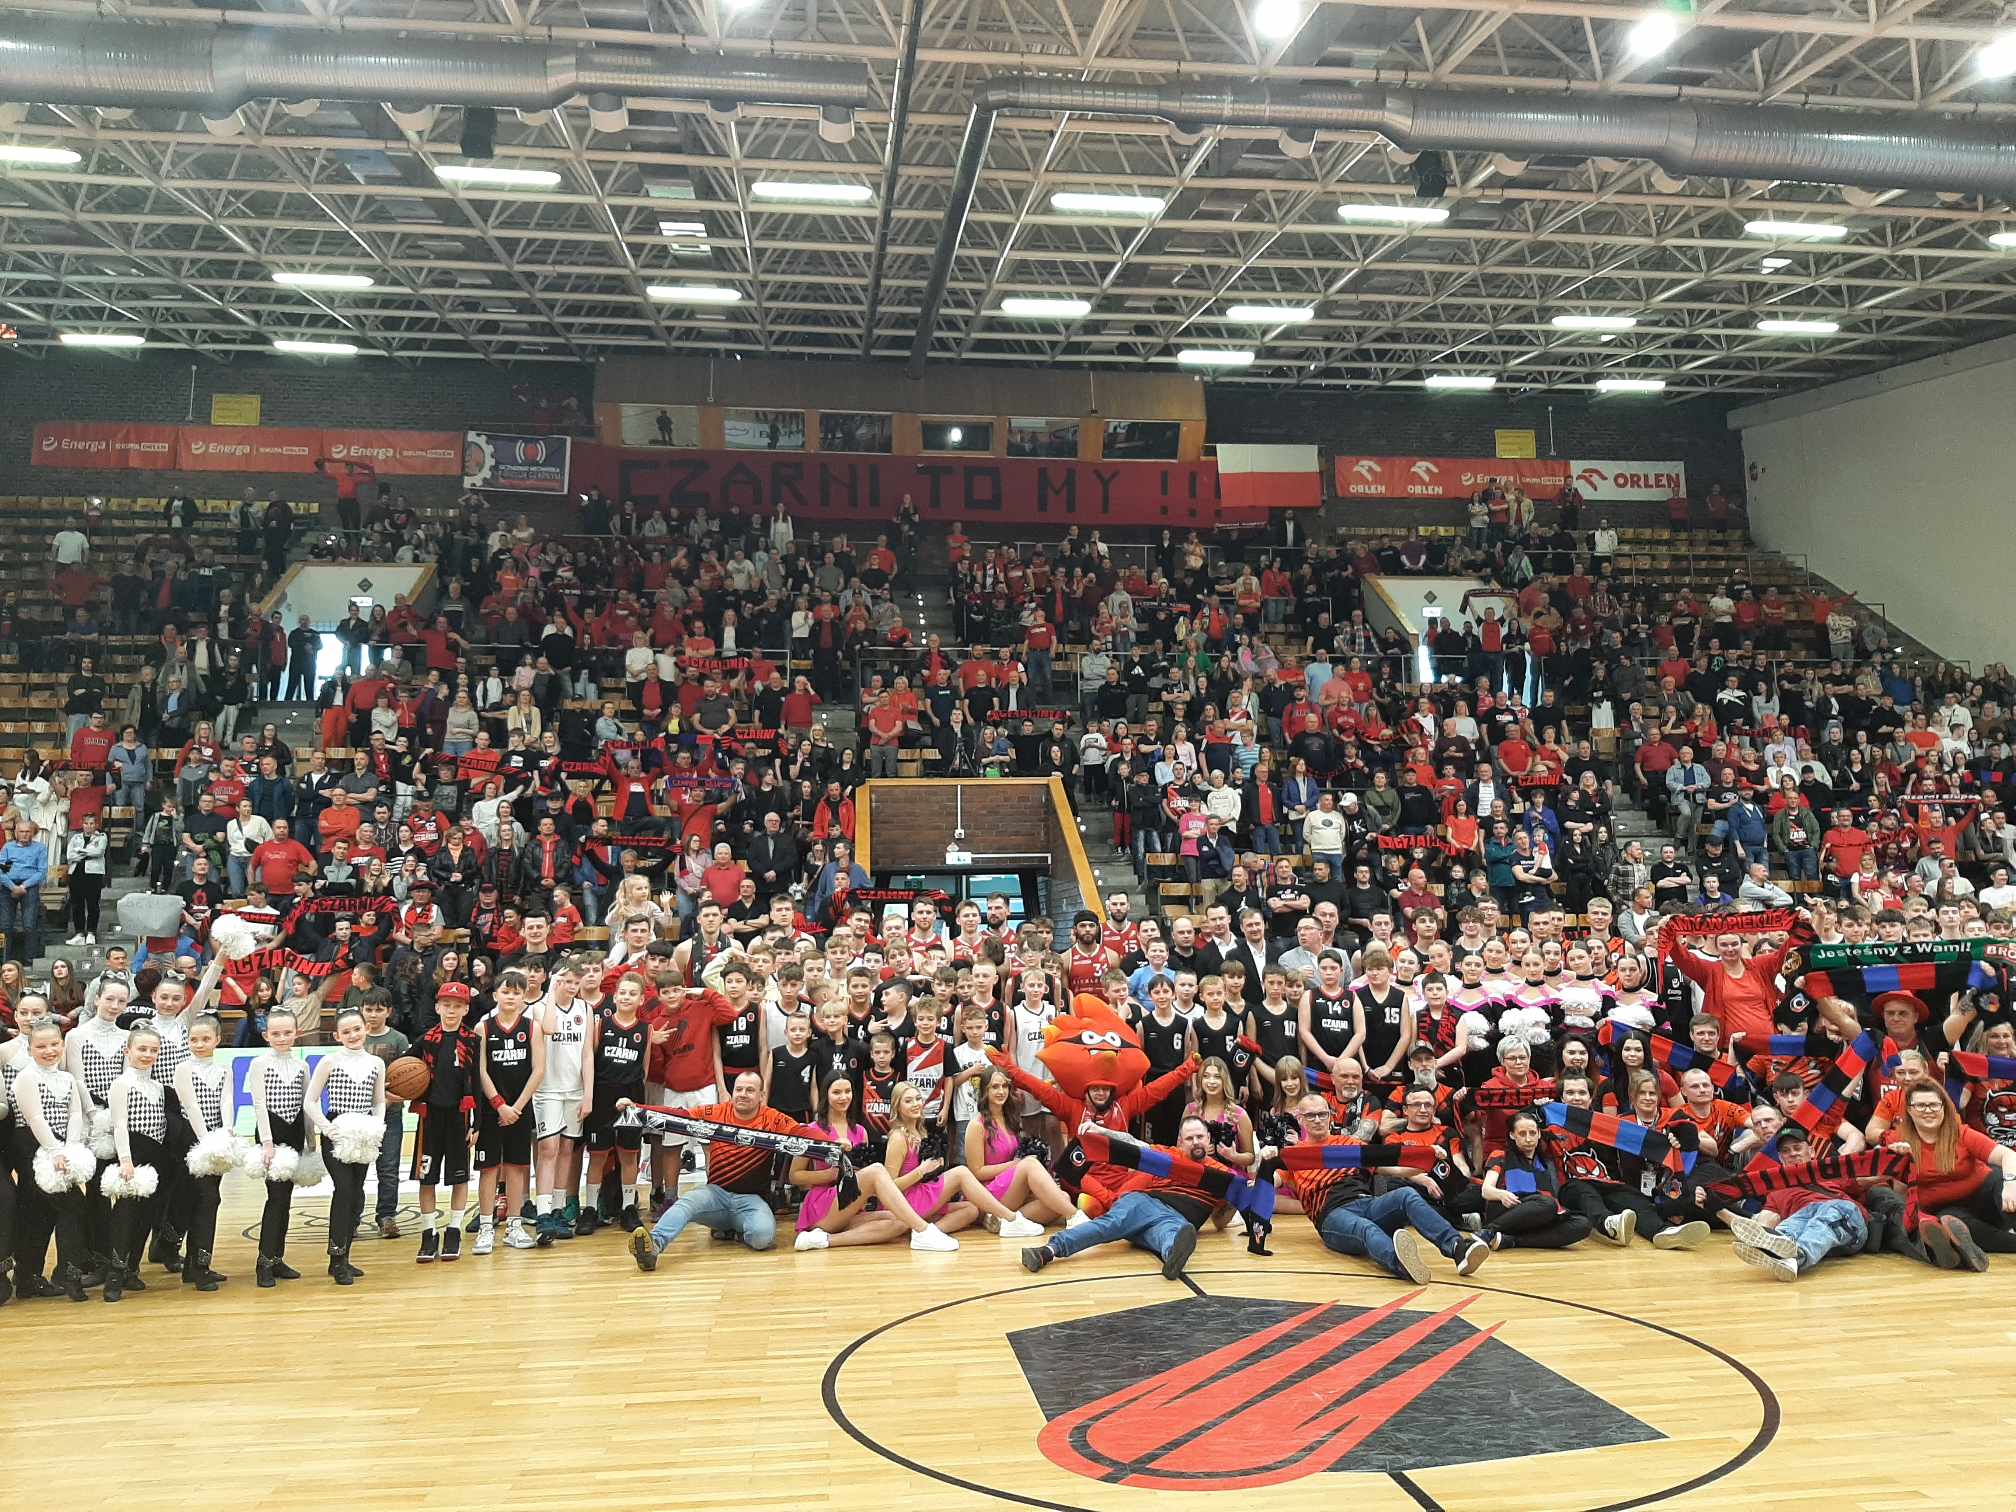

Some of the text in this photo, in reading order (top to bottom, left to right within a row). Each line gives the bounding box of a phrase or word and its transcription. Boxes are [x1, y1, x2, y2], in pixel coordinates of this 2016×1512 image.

[61, 438, 106, 453] Energa
[208, 442, 250, 455] Energa
[350, 446, 394, 459] Energa
[618, 459, 880, 509] CZARNI
[913, 464, 1001, 510] TO
[1037, 466, 1119, 514] MY
[1613, 472, 1681, 489] ORLEN
[1349, 484, 1386, 495] ORLEN
[1407, 485, 1443, 495] ORLEN
[318, 899, 374, 913] CZARNI
[1122, 940, 1137, 953] 15
[1817, 943, 1898, 959] Jesteśmy
[1902, 945, 1912, 954] z
[126, 1005, 158, 1017] CURITY
[1326, 1001, 1341, 1015] 14
[1384, 1006, 1400, 1024] 15
[562, 1021, 572, 1031] 12
[857, 1025, 865, 1038] 6
[1284, 1020, 1297, 1037] 10
[552, 1032, 582, 1043] CZARNI
[618, 1037, 628, 1048] 11
[1173, 1033, 1182, 1050] 6
[492, 1049, 527, 1062] CZARNI
[604, 1046, 639, 1061] CZARNI
[801, 1065, 811, 1083] 4
[865, 1102, 891, 1113] CZARN
[537, 1122, 547, 1133] 12
